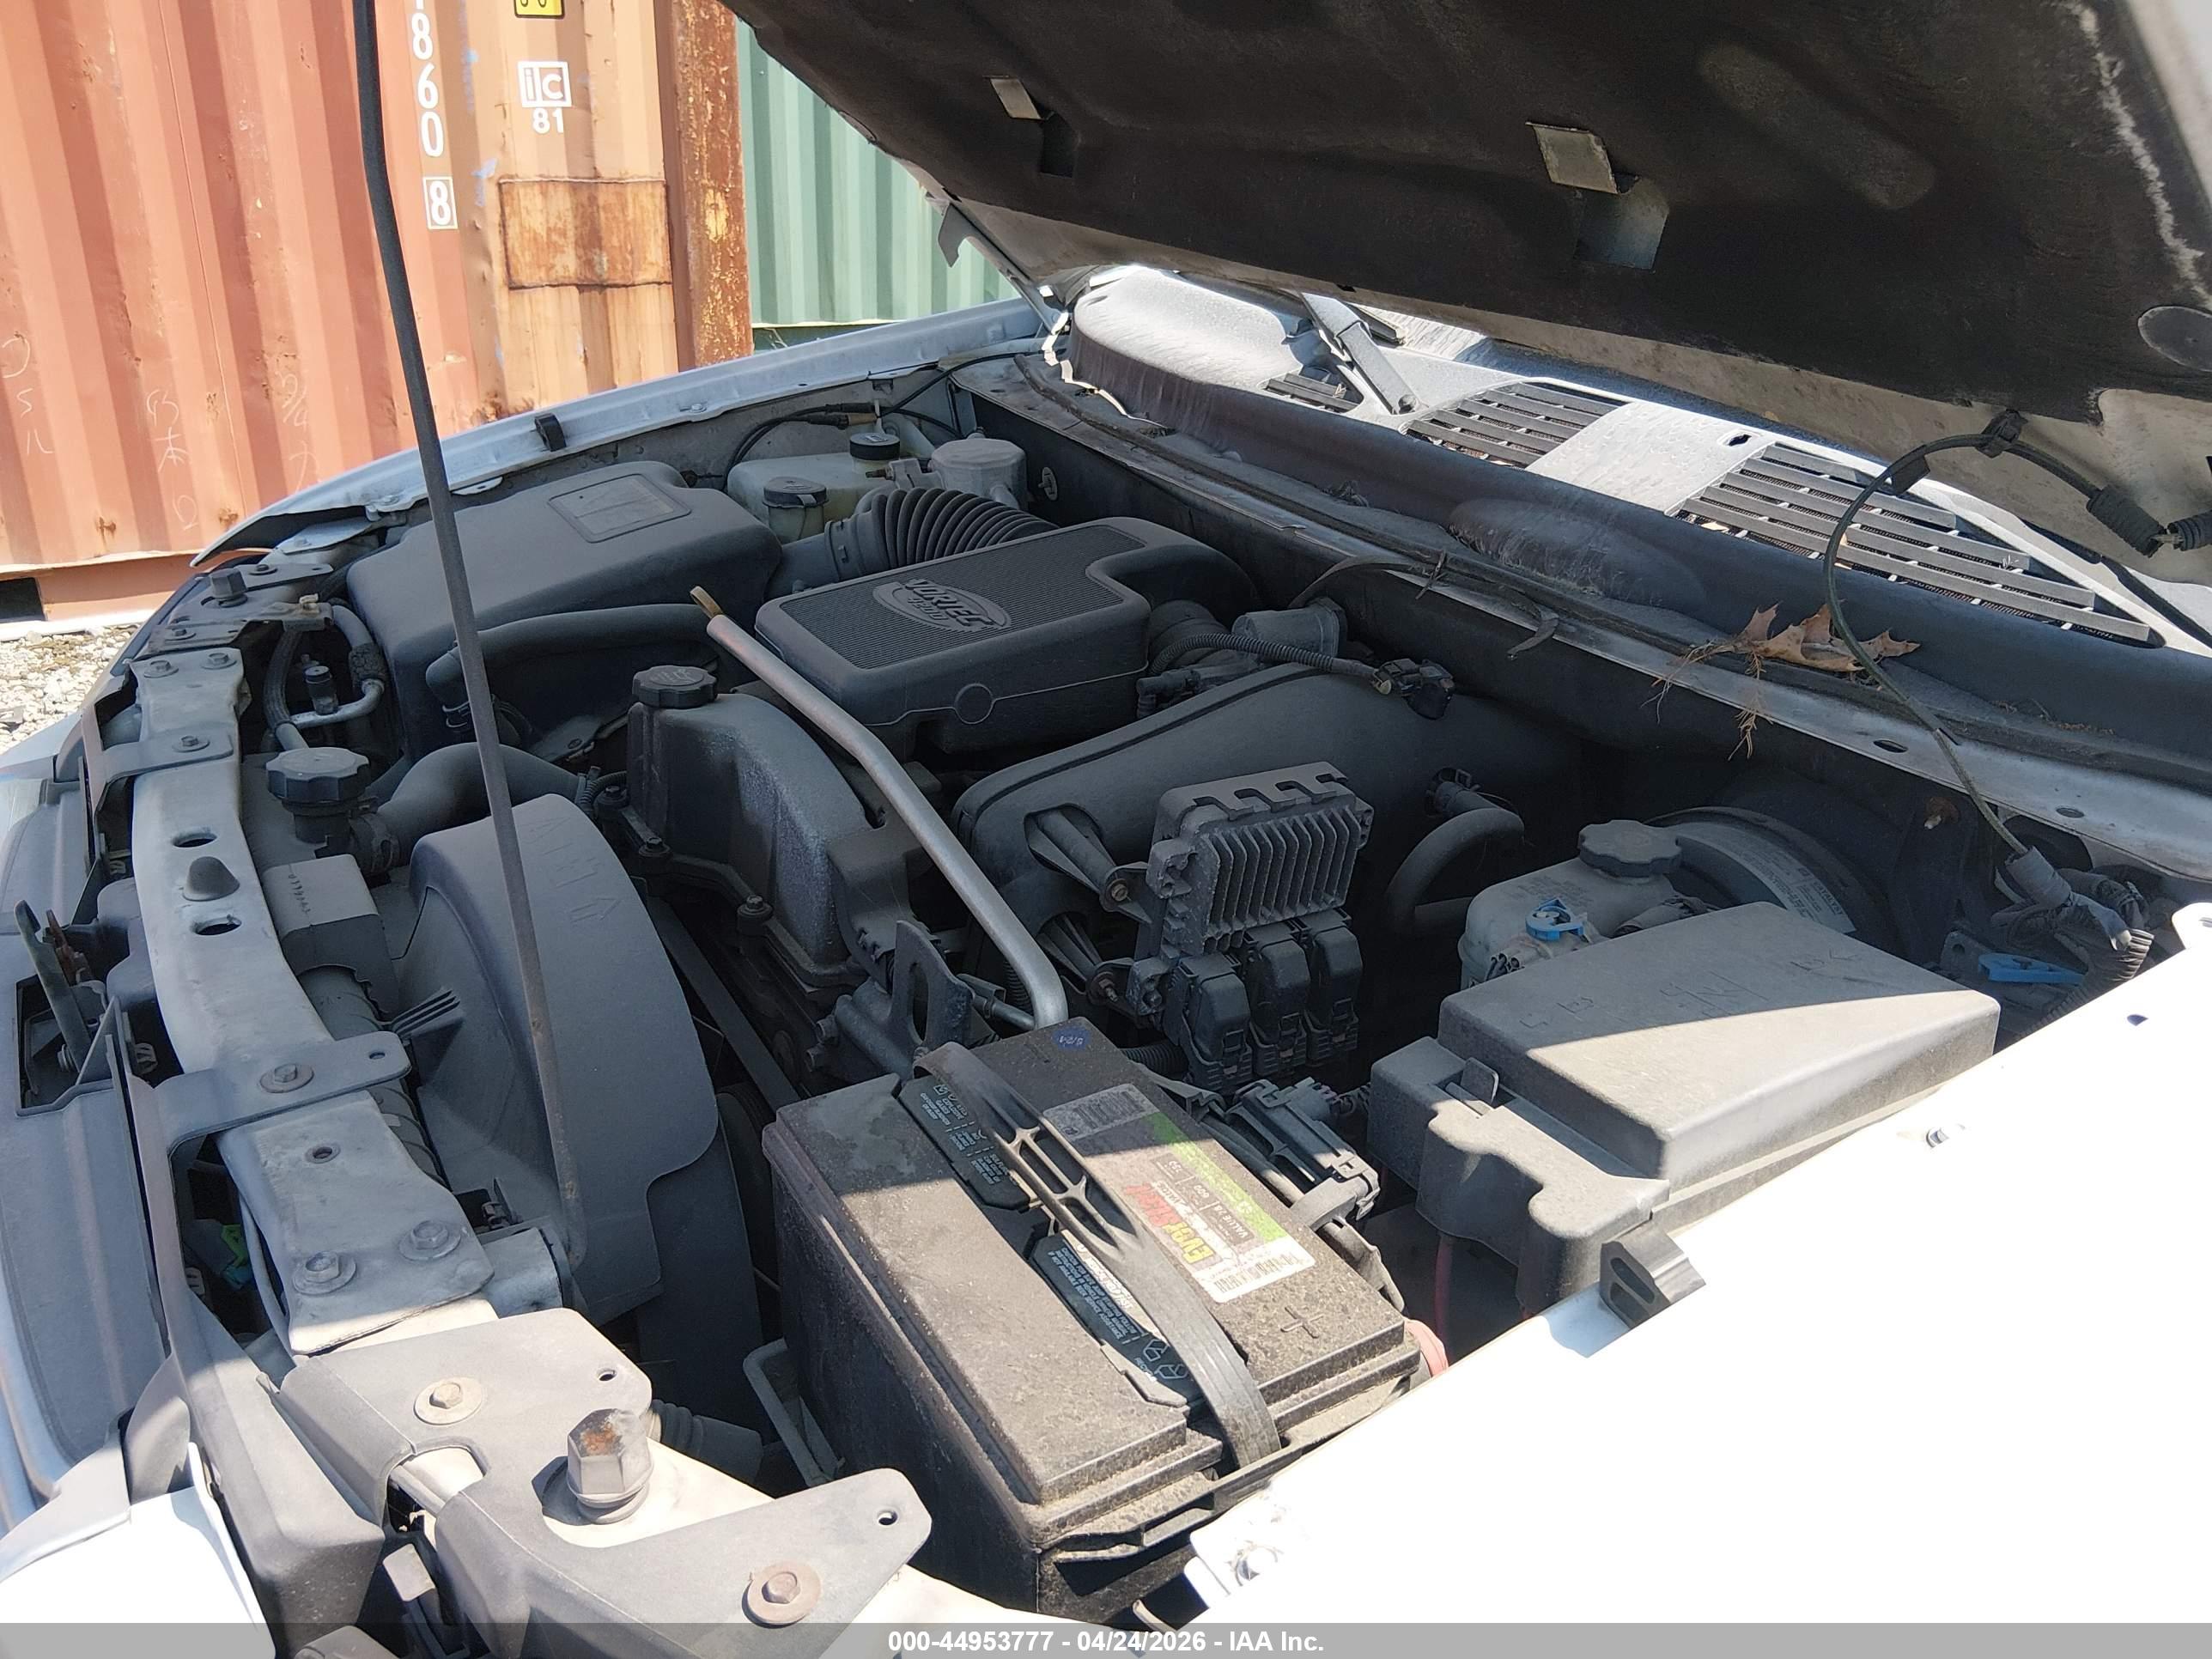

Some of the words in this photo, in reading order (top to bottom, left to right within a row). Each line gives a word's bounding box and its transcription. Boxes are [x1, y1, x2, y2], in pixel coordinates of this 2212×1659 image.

[412, 0, 444, 157] 860
[532, 108, 564, 134] 81
[904, 580, 994, 625] VORTEC
[1221, 1212, 1248, 1238] VALUE
